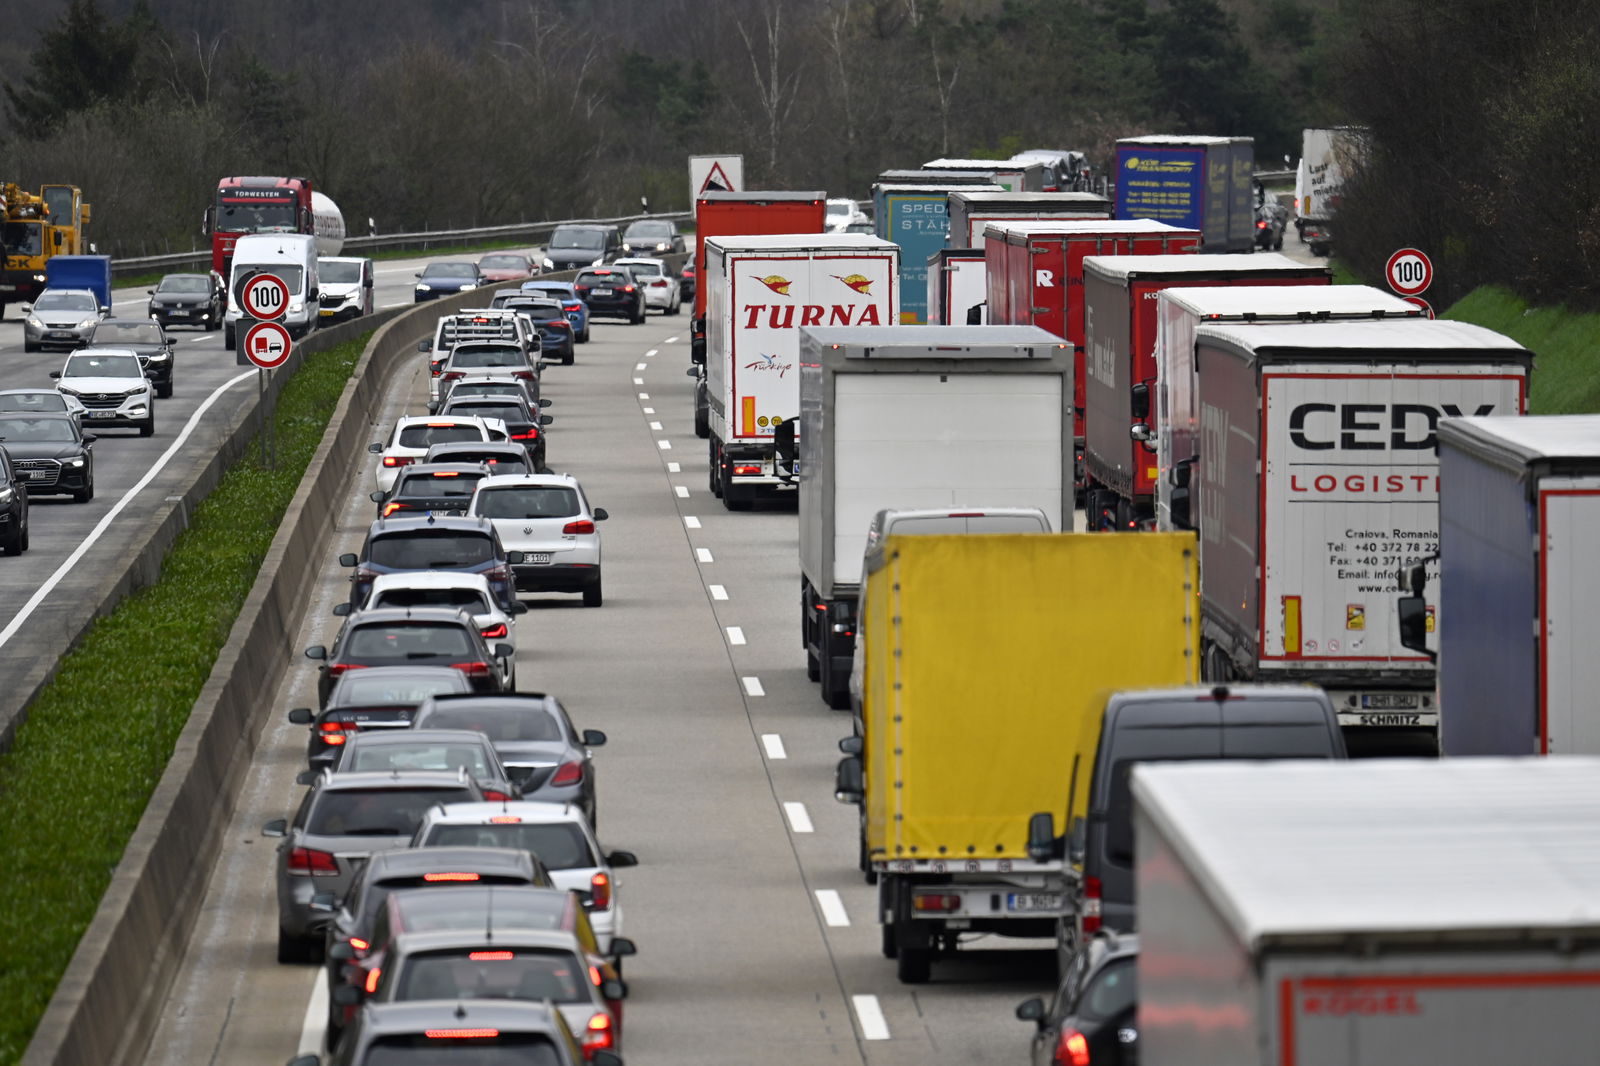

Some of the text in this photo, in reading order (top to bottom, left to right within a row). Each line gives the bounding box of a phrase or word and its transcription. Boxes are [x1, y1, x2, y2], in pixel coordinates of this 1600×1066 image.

[235, 190, 280, 198] TORWESTEN
[1036, 269, 1055, 287] R
[1395, 261, 1423, 283] 100
[252, 286, 280, 308] 100
[743, 303, 881, 329] TURNA
[1289, 403, 1496, 450] CED
[1345, 528, 1438, 540] Craiova, Romania
[1355, 542, 1377, 552] +40
[1381, 542, 1402, 553] 372
[1357, 555, 1378, 566] +40
[1361, 715, 1420, 725] SCHMITZ
